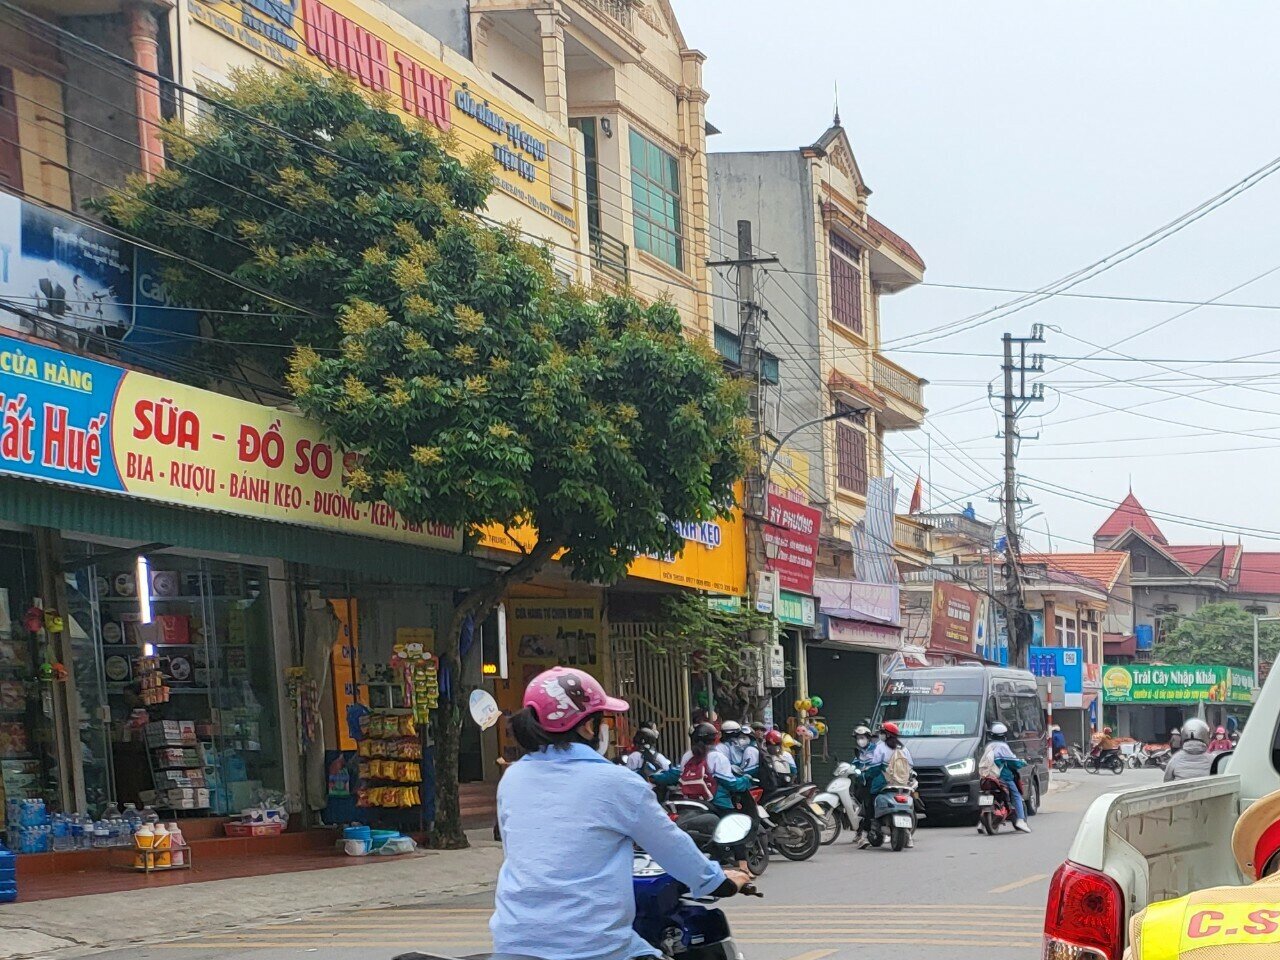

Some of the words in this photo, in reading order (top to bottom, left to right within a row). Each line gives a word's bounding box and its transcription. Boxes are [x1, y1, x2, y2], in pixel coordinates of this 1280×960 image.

[302, 0, 391, 95] MINH
[394, 50, 452, 132] THƯ
[1, 348, 38, 378] CỬA
[44, 361, 93, 392] HÀNG
[0, 393, 35, 463] ất
[45, 405, 106, 474] Huế
[133, 397, 200, 451] SỮA
[238, 419, 285, 468] ĐỒ
[294, 438, 333, 479] SƠ
[126, 452, 154, 482] BIA
[170, 460, 216, 497] RƯỢU
[229, 470, 270, 504] BÁNH
[274, 483, 302, 513] KẸO
[314, 489, 360, 521] ĐƯỜNG
[700, 520, 720, 548] KẸO
[1152, 669, 1168, 687] Cây
[1170, 670, 1194, 687] Nhập
